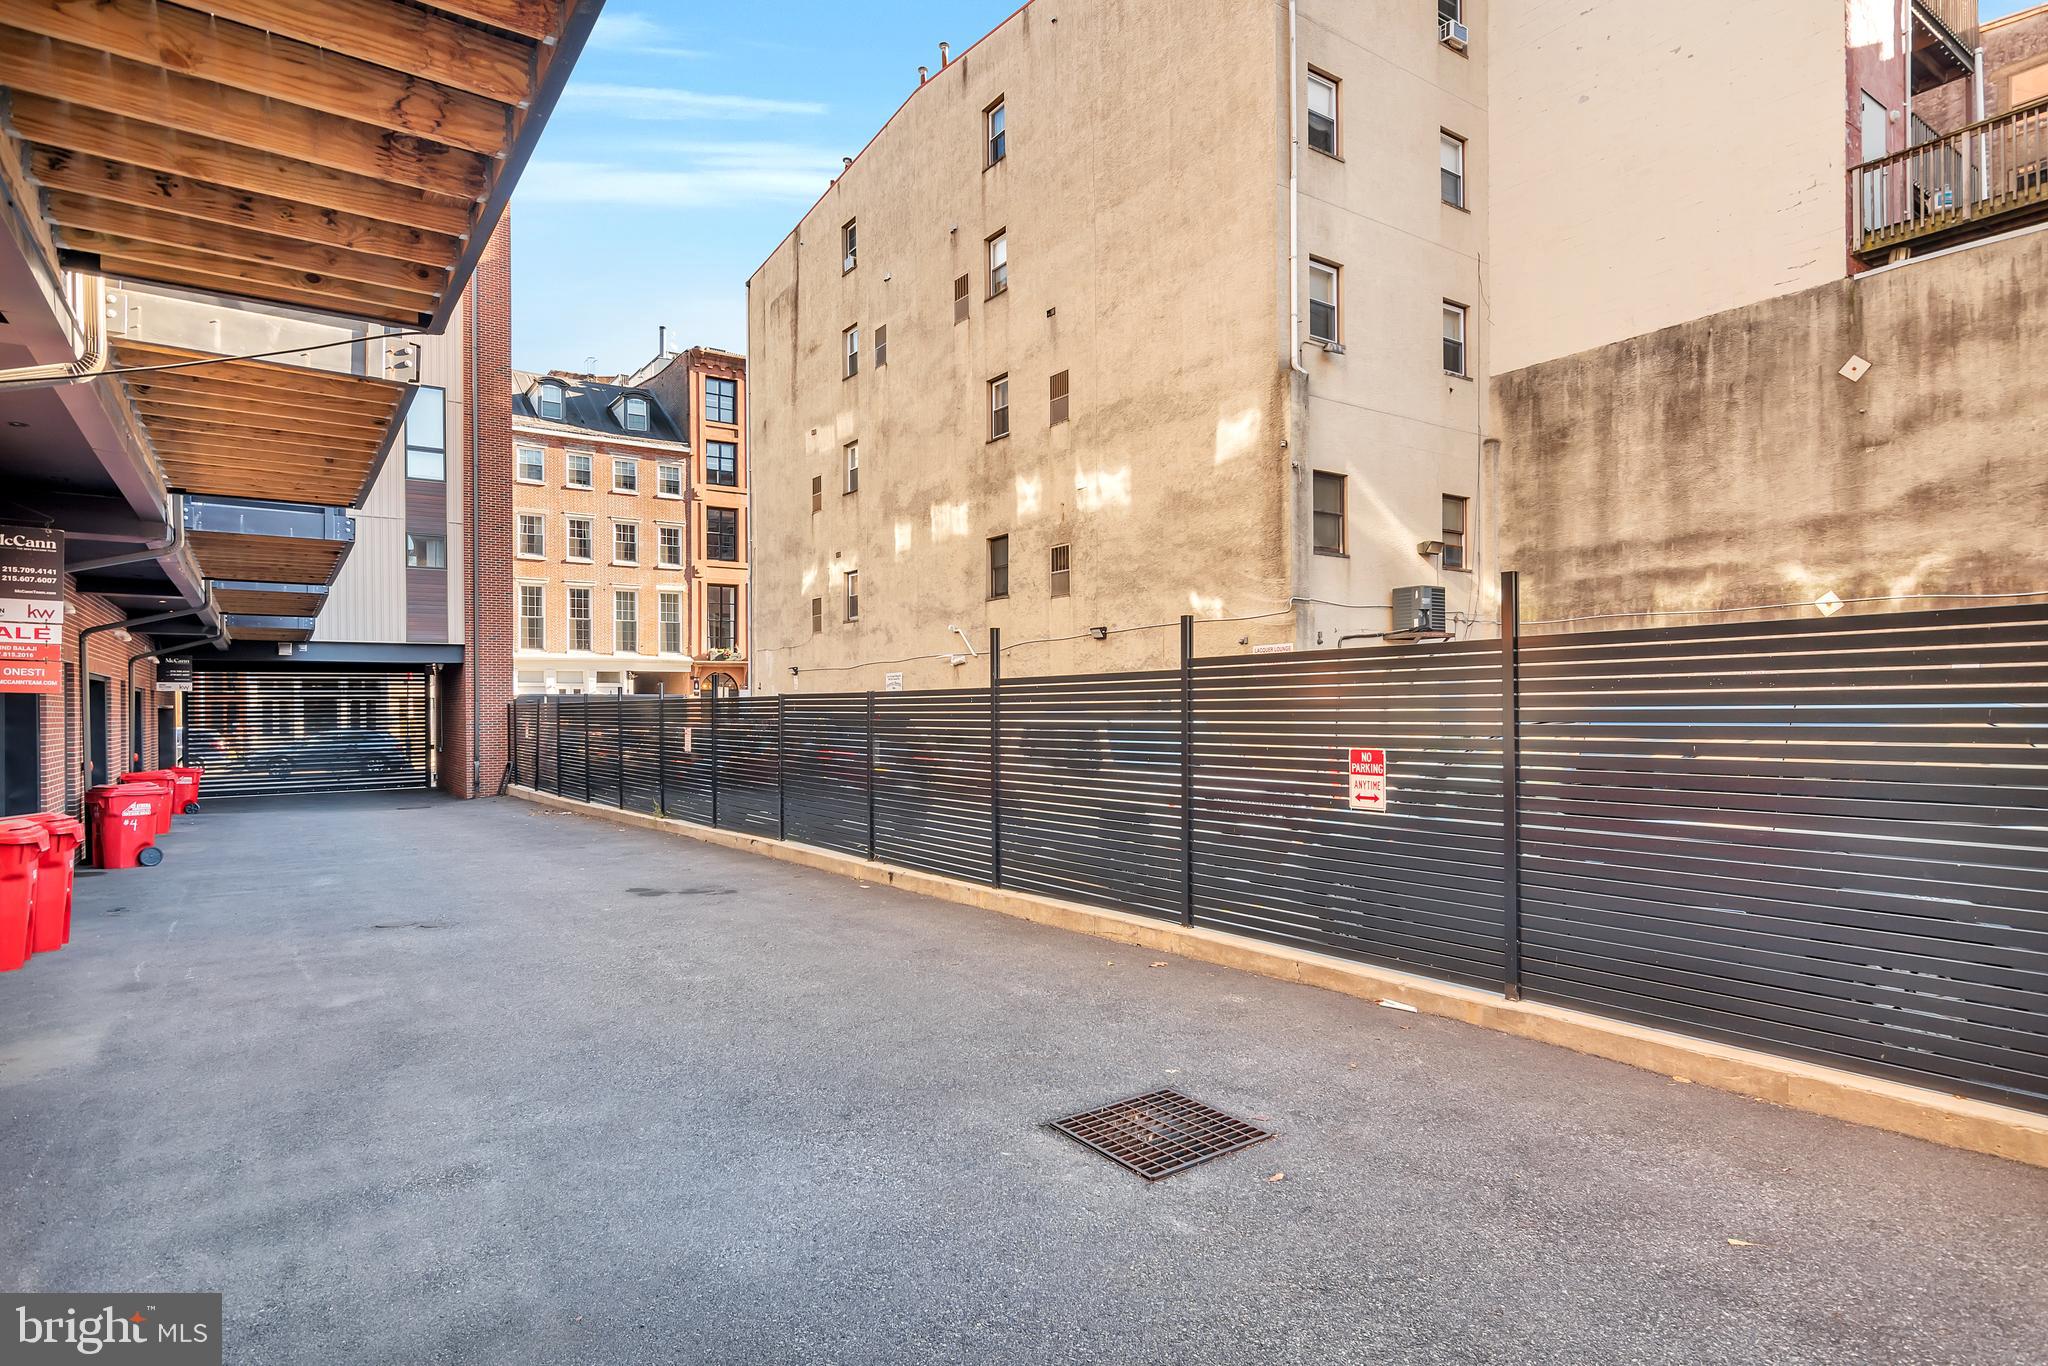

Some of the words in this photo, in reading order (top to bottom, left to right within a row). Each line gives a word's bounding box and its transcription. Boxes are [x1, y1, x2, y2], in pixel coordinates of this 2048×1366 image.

[1, 565, 57, 575] 215.709.4141
[1, 574, 58, 584] 215.607.6007
[28, 603, 55, 619] kw
[3, 667, 45, 677] ONESTI
[1361, 751, 1372, 763] NO
[1351, 763, 1384, 775] PARKING
[1354, 780, 1380, 791] ANYTIME
